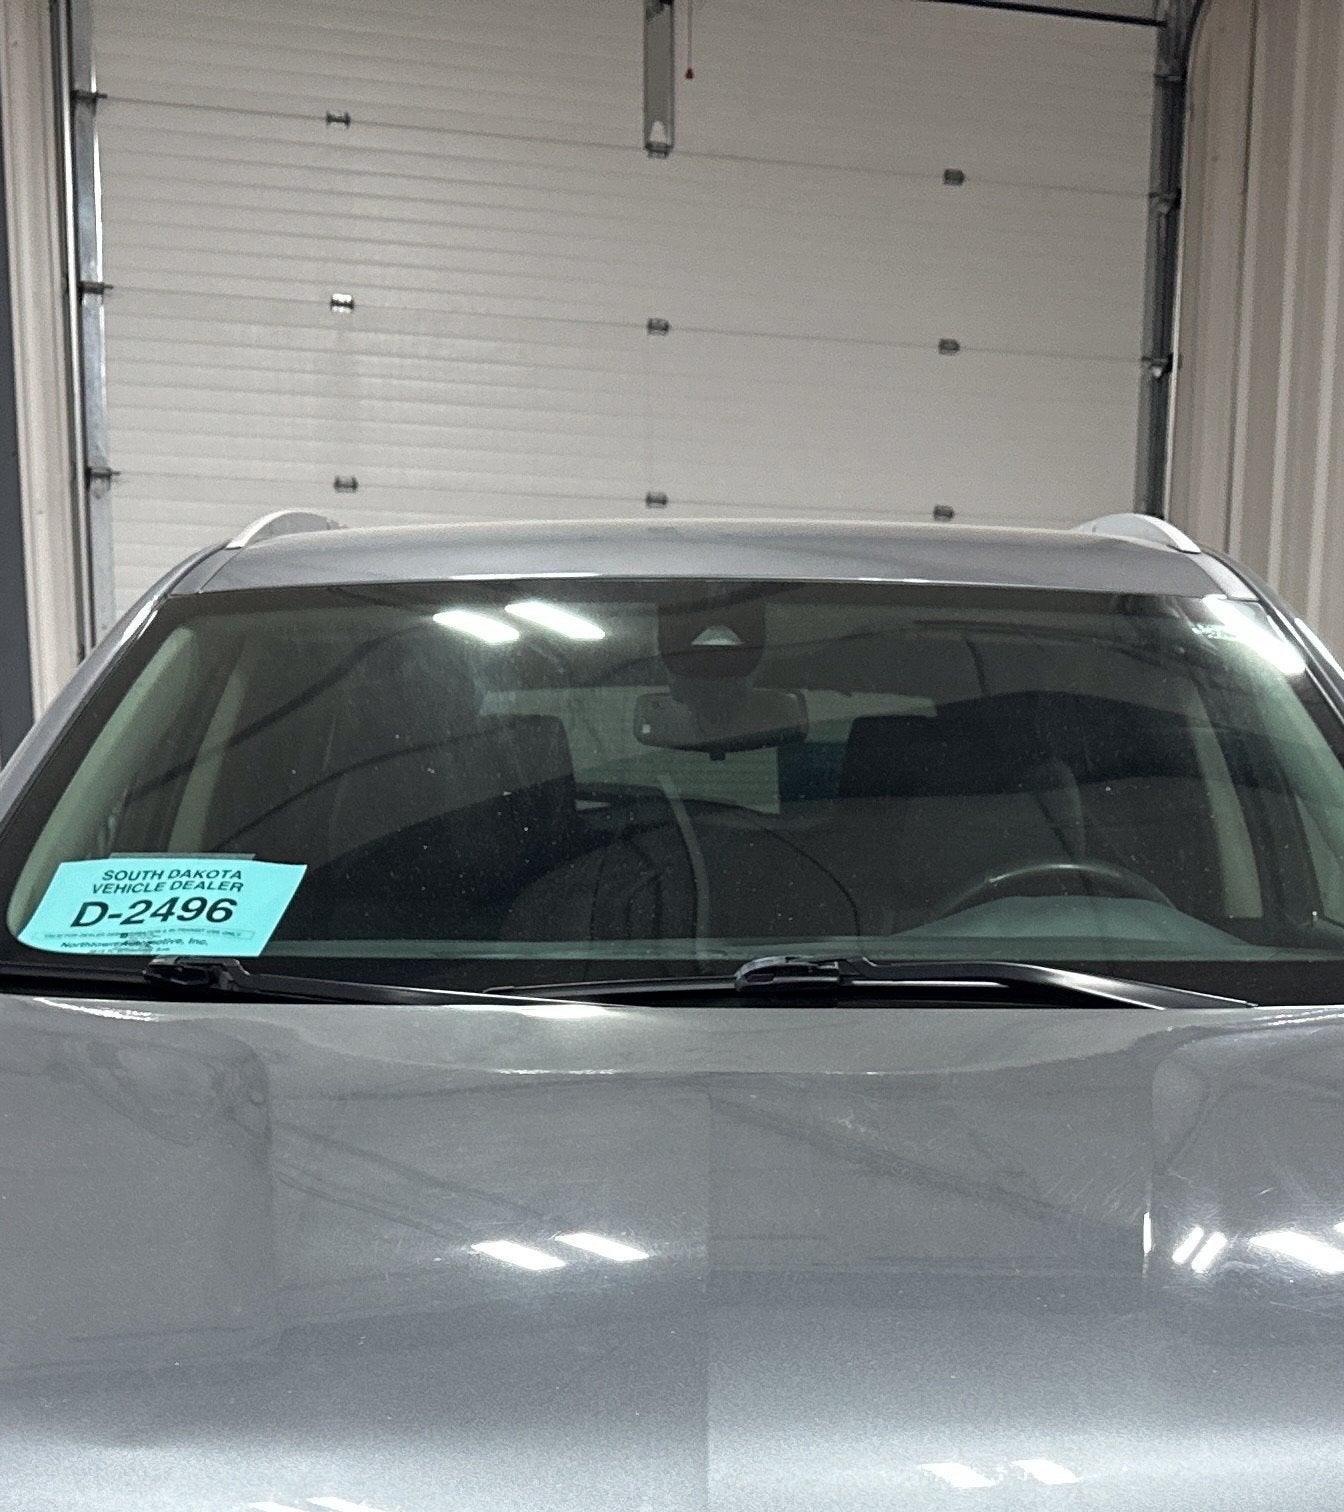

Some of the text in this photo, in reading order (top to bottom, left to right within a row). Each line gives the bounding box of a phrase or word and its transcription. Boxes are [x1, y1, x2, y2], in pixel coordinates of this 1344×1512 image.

[102, 869, 242, 882] SOUTH DAKOTA
[92, 880, 244, 895] VEHICLE DEALER
[70, 896, 238, 928] D-2496
